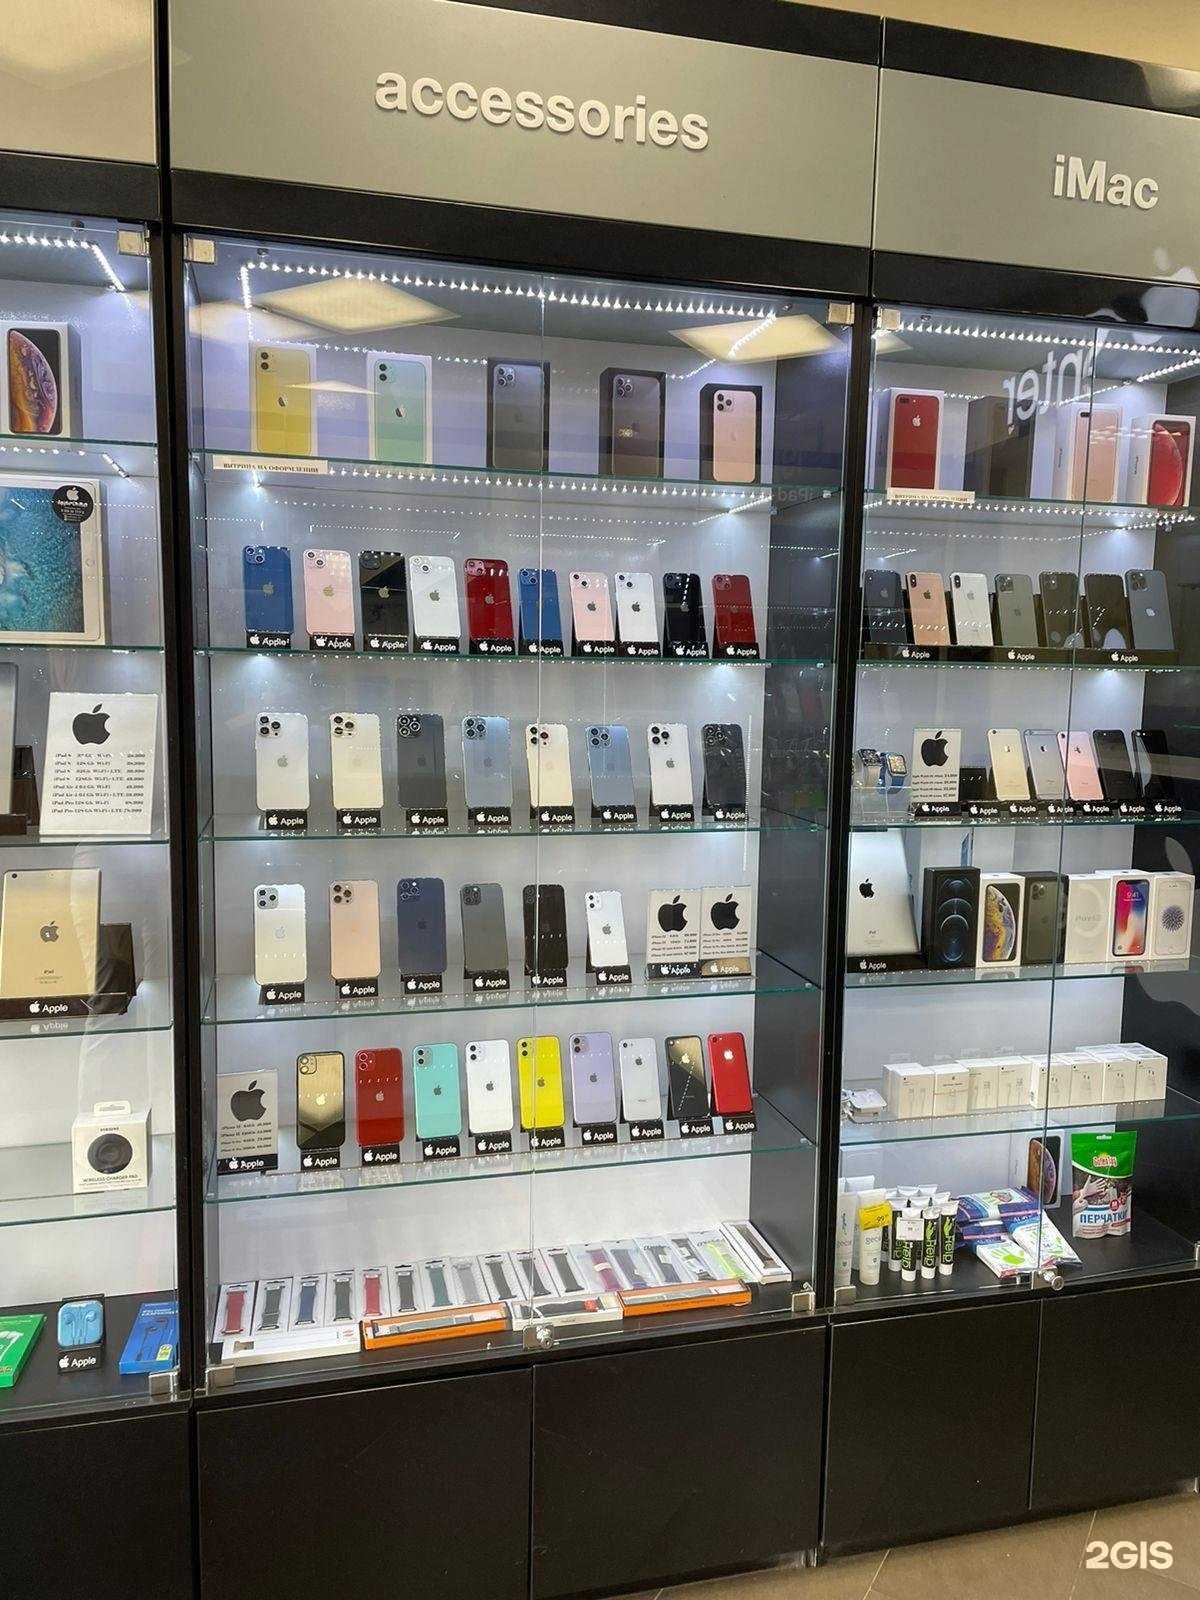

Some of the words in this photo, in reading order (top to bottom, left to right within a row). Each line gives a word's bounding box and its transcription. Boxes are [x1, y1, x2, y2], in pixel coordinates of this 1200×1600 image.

[375, 71, 709, 150] accessories
[1053, 153, 1159, 209] iMac
[262, 636, 287, 647] Apple
[328, 638, 351, 649] Apple
[382, 638, 405, 649] Apple
[434, 641, 456, 651] Apple
[491, 644, 513, 653] Apple
[540, 645, 561, 654] Apple
[594, 645, 615, 654] Apple
[638, 647, 659, 656] Apple
[686, 647, 707, 656] Apple
[737, 648, 757, 657] Apple
[911, 650, 930, 659] Apple
[1016, 652, 1036, 661] Apple
[1120, 654, 1139, 663] Apple
[931, 805, 950, 813] Apple
[979, 807, 998, 815] Apple
[1019, 805, 1037, 813] Apple
[1092, 805, 1110, 813] Apple
[1129, 805, 1146, 813] Apple
[1164, 805, 1182, 813] Apple
[354, 815, 378, 824] Apple
[422, 815, 445, 825] Apple
[487, 813, 509, 823] Apple
[552, 813, 573, 823] Apple
[614, 812, 634, 821] Apple
[671, 811, 692, 821] Apple
[726, 811, 746, 820] Apple
[281, 816, 304, 826] Apple
[671, 965, 691, 975] Apple
[719, 964, 740, 974] Apple
[868, 961, 887, 970] Apple
[543, 976, 564, 986] Apple
[609, 973, 629, 982] Apple
[418, 980, 440, 990] Apple
[485, 978, 507, 988] Apple
[278, 990, 302, 1000] Apple
[353, 985, 376, 995] Apple
[42, 1002, 69, 1014] Apple
[690, 1124, 711, 1134] Apple
[734, 1121, 755, 1131] Apple
[594, 1131, 614, 1141] Apple
[641, 1127, 662, 1137] Apple
[488, 1139, 510, 1150] Apple
[541, 1136, 562, 1146] Apple
[435, 1145, 457, 1156] Apple
[315, 1156, 338, 1166] Apple
[375, 1151, 398, 1162] Apple
[240, 1158, 264, 1169] Apple
[1080, 1209, 1128, 1224] ПЕРЧАТКИ
[71, 1355, 97, 1367] Apple
